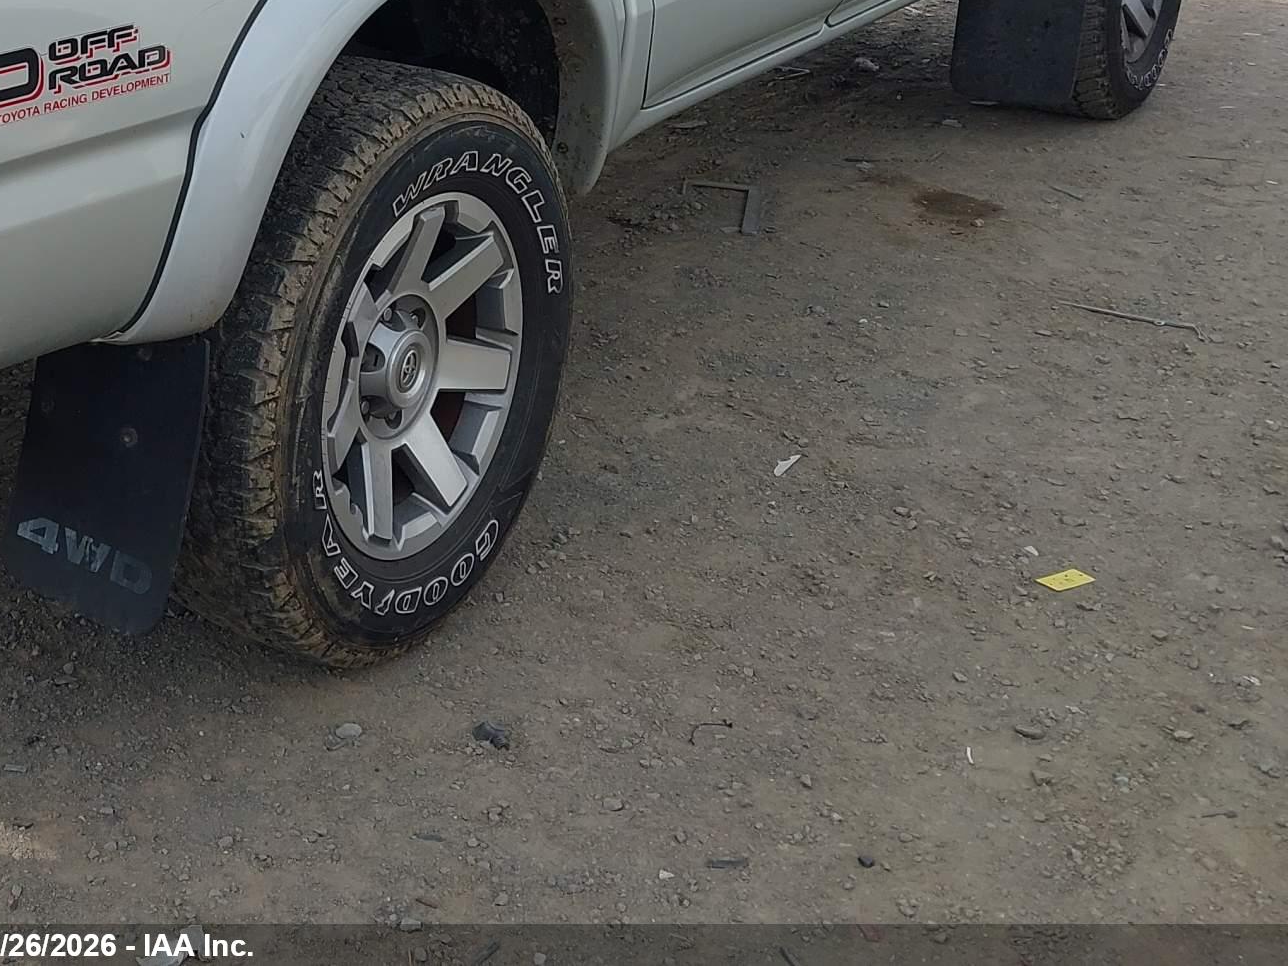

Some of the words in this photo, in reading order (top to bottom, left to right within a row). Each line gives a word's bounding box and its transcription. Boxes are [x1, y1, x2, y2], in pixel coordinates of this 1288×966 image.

[48, 23, 139, 64] OFF
[48, 43, 171, 94] ROAD
[43, 94, 88, 116] RACING
[90, 73, 171, 104] DEVELOPMENT
[392, 150, 562, 294] WRANGLER
[16, 517, 153, 595] 4WD
[313, 469, 499, 616] GOODYEAR
